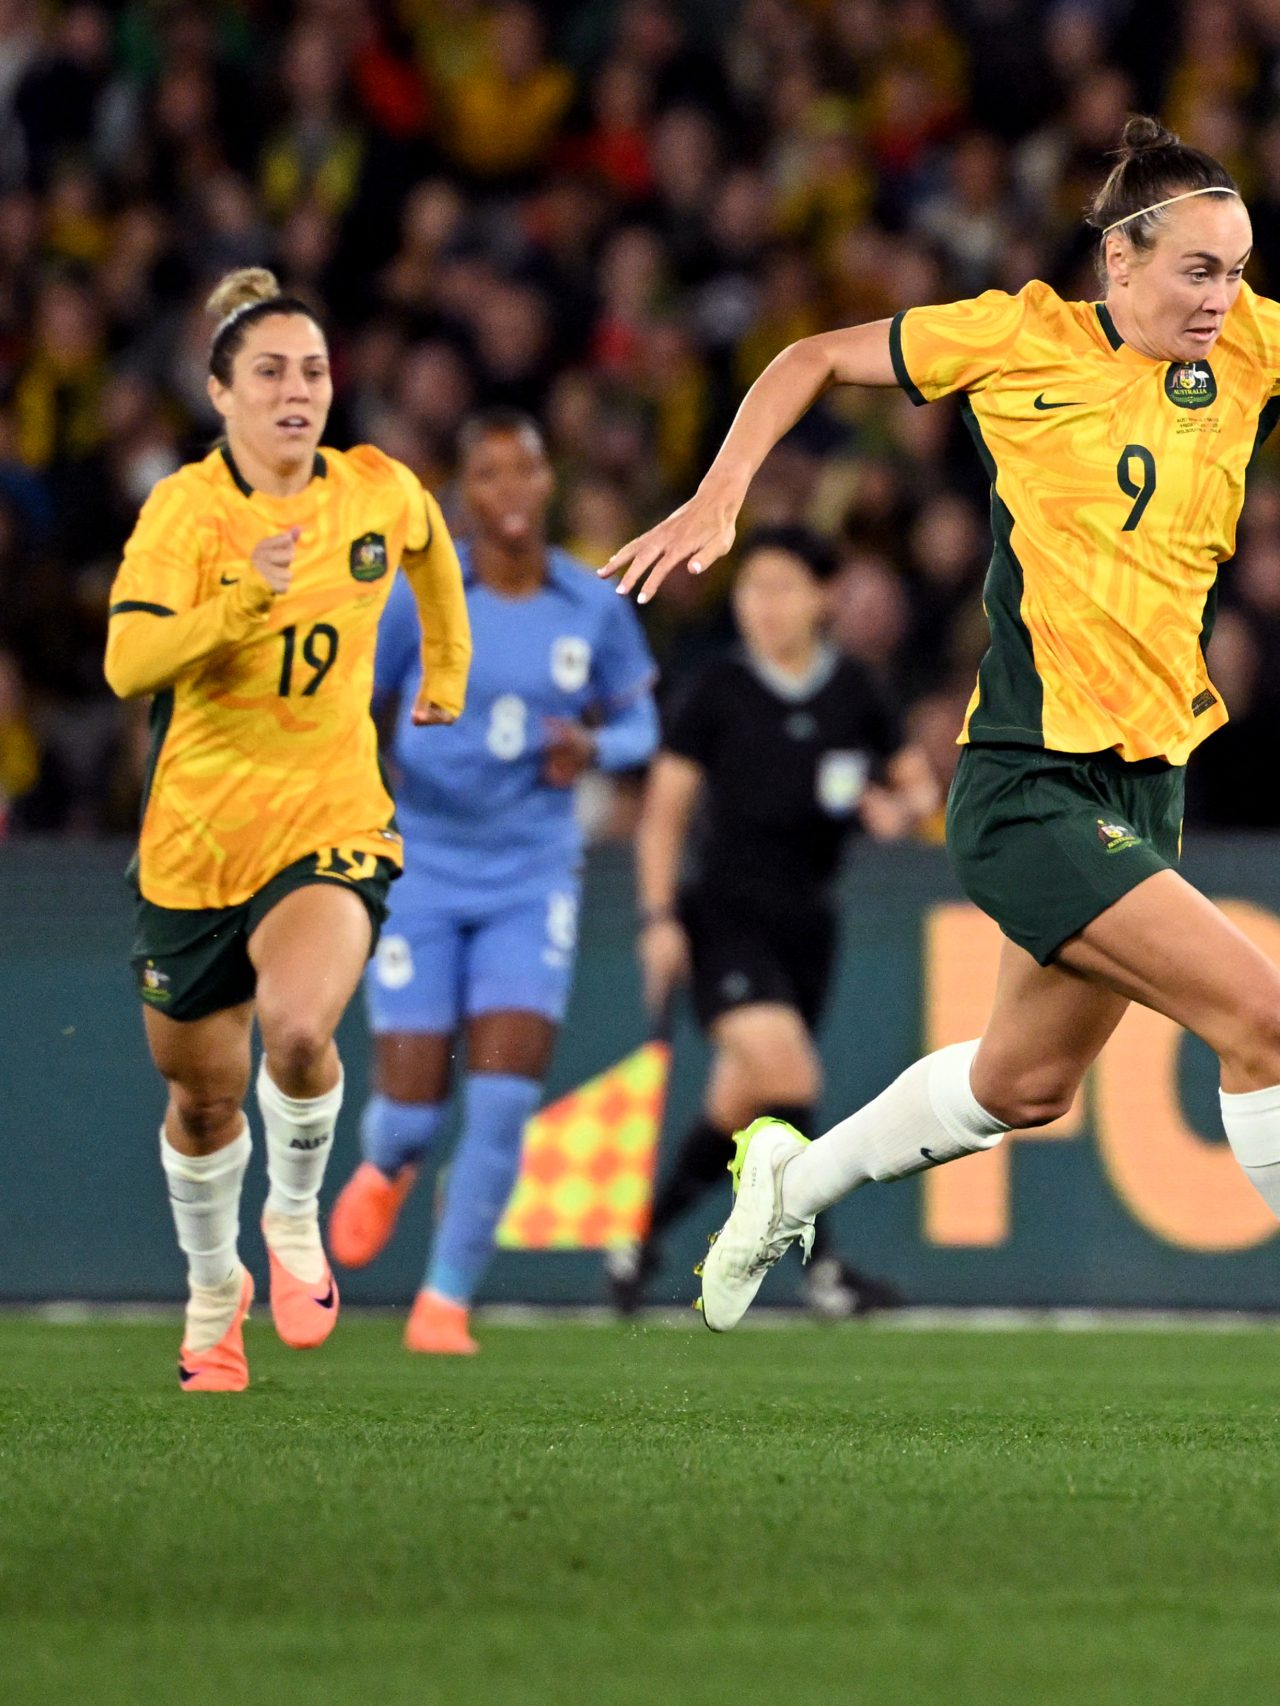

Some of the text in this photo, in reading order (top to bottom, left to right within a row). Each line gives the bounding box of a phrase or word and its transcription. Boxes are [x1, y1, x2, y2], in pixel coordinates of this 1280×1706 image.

[1173, 388, 1207, 396] AUSTRALIA
[1116, 444, 1157, 532] 9
[278, 623, 339, 698] 19
[486, 694, 527, 762] 8
